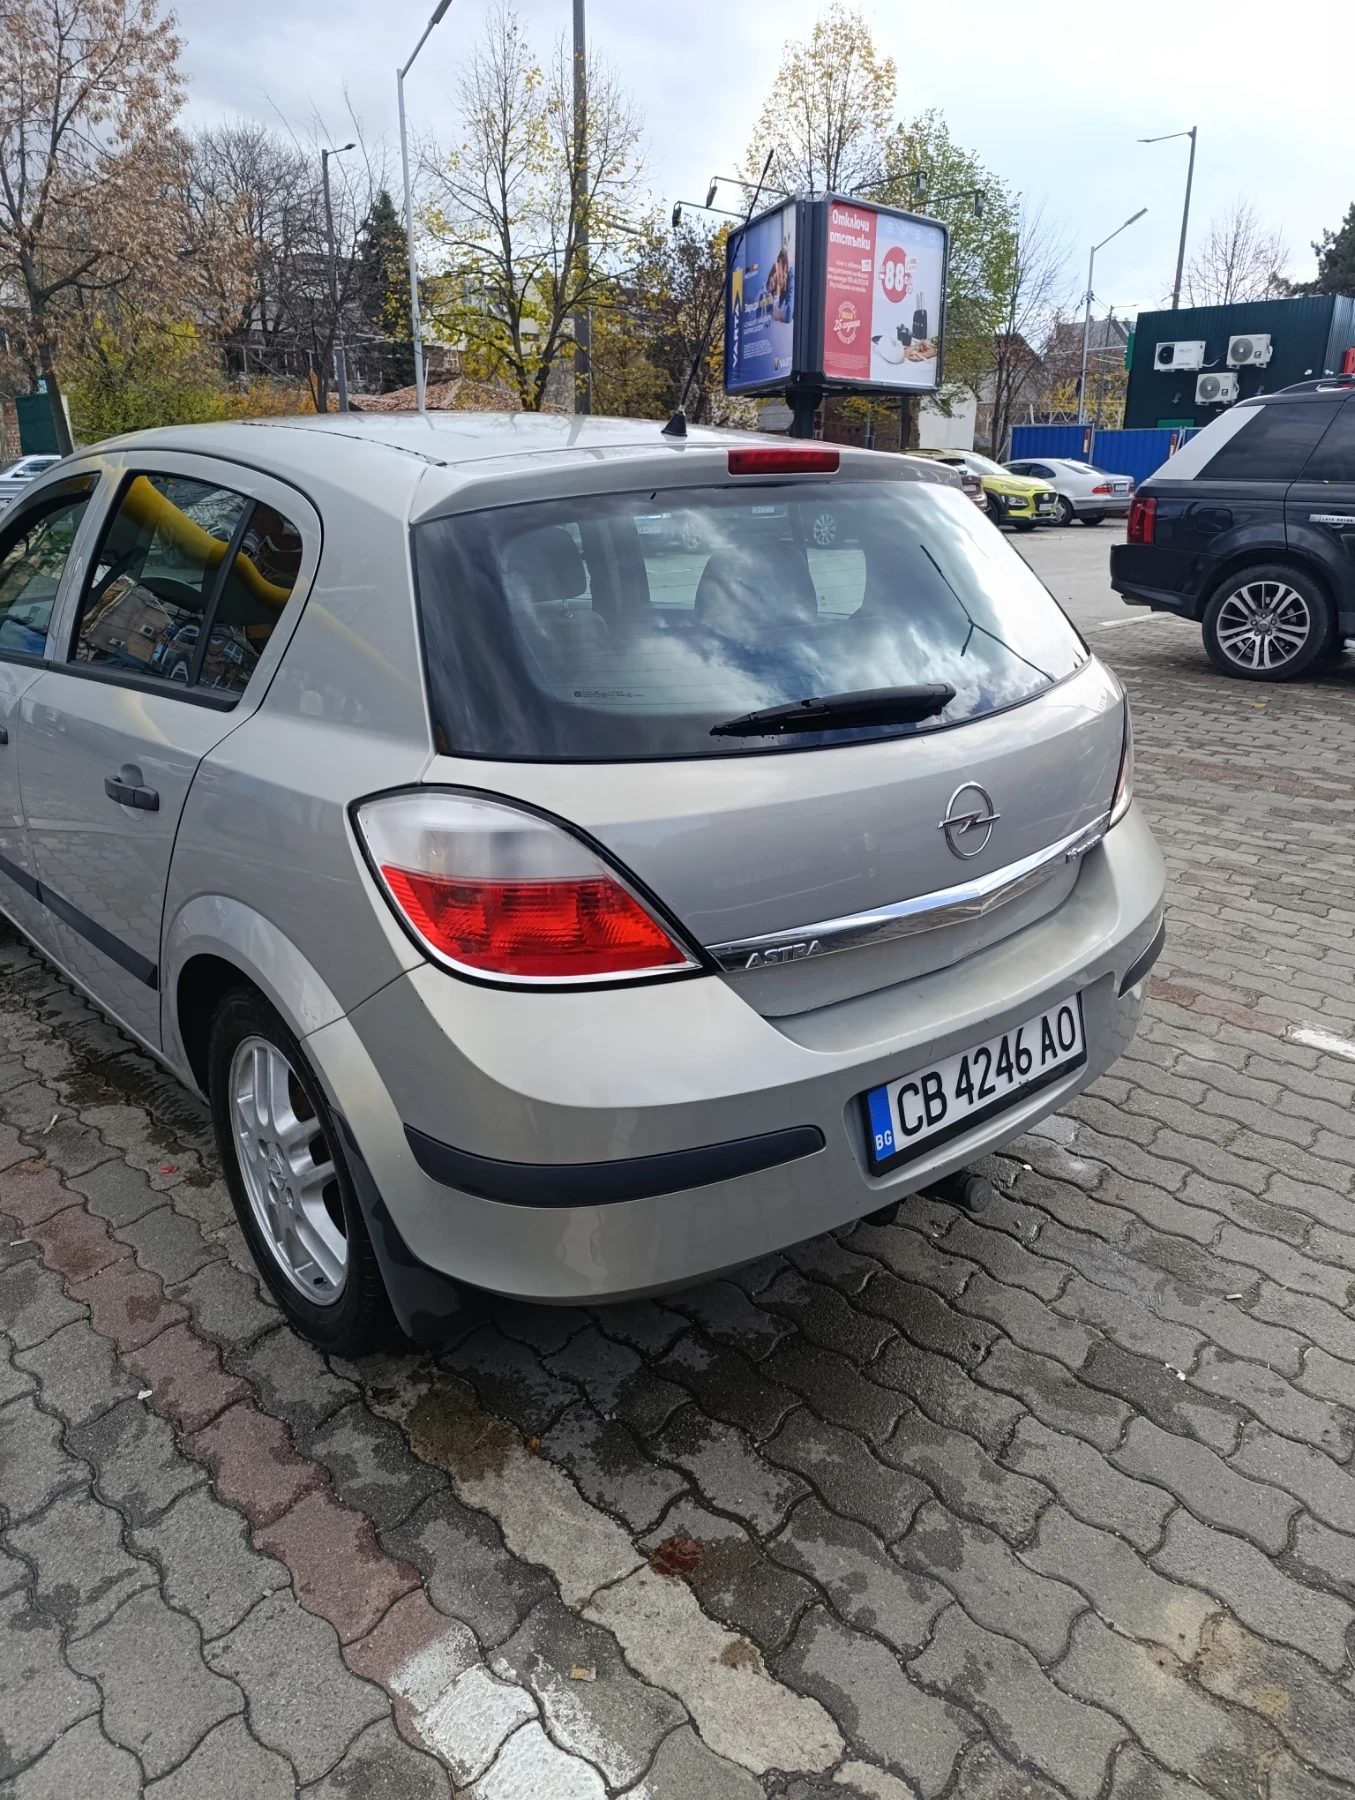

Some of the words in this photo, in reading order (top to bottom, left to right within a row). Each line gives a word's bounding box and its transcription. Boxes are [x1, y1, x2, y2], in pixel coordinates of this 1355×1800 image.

[832, 209, 870, 232] Отключи
[829, 231, 871, 251] отстъпки
[732, 303, 740, 369] VARTA
[744, 939, 824, 969] ASTRA
[897, 1071, 948, 1137] CB
[955, 1027, 1033, 1106] 4246
[1040, 1005, 1076, 1066] AO
[875, 1129, 893, 1151] BG
